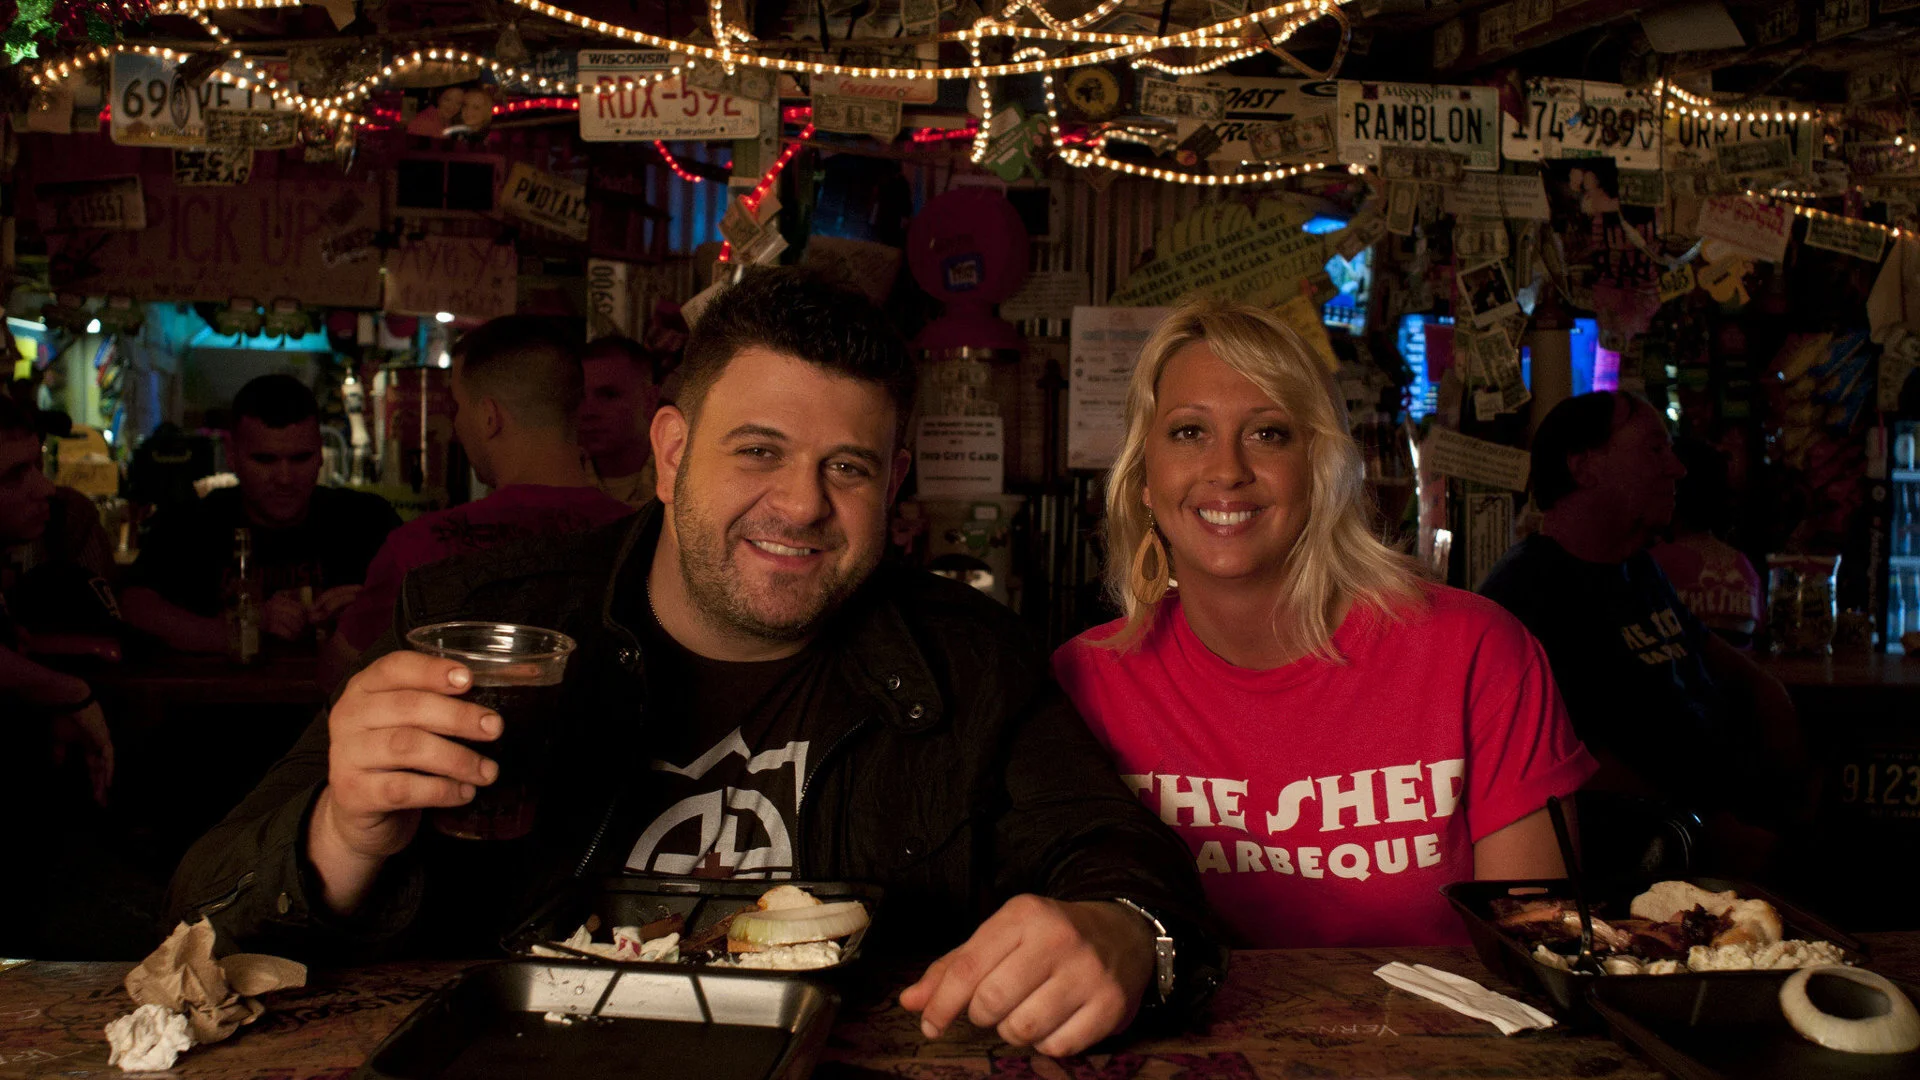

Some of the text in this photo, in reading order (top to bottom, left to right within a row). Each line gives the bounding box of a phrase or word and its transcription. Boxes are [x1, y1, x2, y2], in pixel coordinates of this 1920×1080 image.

[588, 53, 670, 65] WISCONSIN
[1355, 103, 1482, 144] RAMBLON
[1145, 259, 1170, 277] THE
[1176, 243, 1212, 264] SHED
[1119, 758, 1465, 836] THE SHED
[1196, 833, 1441, 882] ARBEQUE
